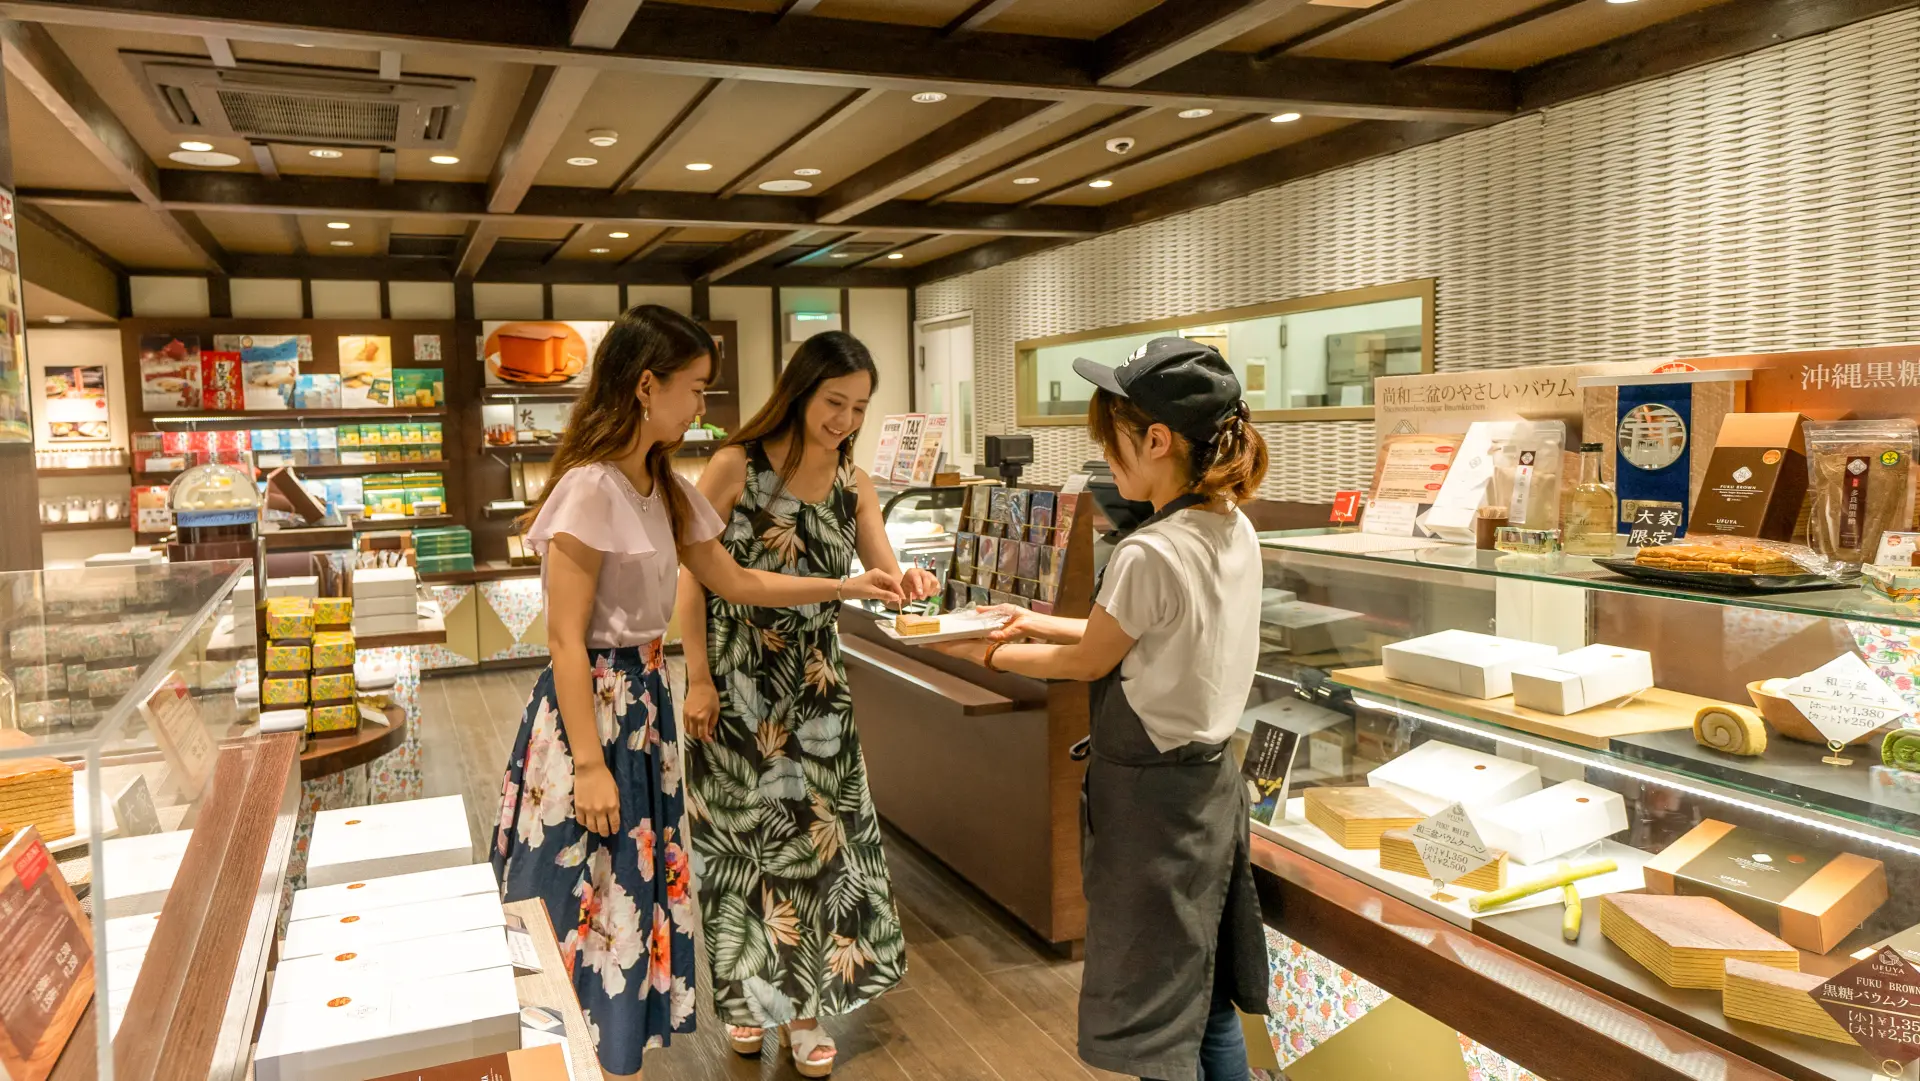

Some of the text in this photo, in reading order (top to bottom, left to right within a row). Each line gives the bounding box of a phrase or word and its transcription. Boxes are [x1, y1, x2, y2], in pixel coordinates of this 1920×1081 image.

[1801, 359, 1920, 390] 沖縄黒糖
[906, 420, 921, 435] TAX
[900, 436, 919, 450] FREE
[1635, 510, 1678, 527] 大家
[1629, 529, 1672, 546] 限定
[1452, 827, 1470, 838] WHITE
[1872, 963, 1905, 975] UFUYA
[1856, 976, 1920, 995] FUKU BROWN
